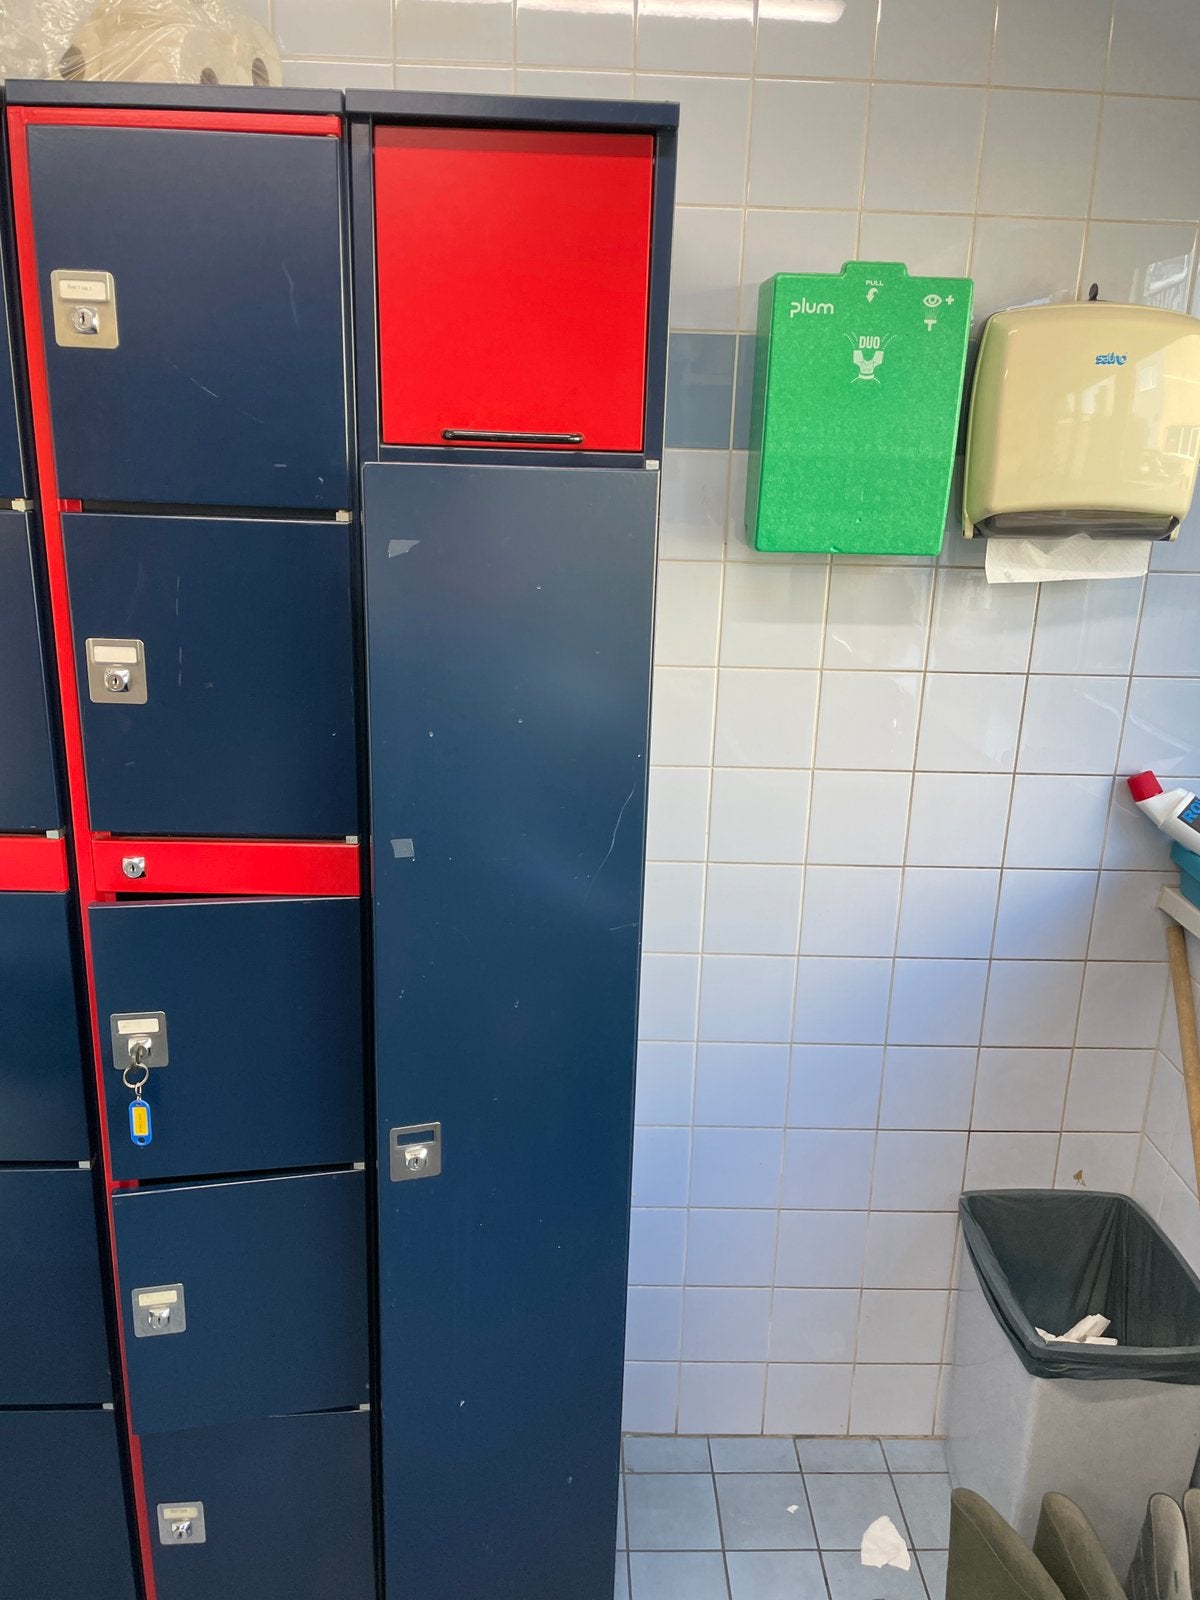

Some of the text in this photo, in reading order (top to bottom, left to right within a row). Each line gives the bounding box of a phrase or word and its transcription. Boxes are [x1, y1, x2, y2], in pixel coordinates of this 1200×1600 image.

[790, 297, 834, 318] plum
[859, 335, 881, 349] DUO
[1183, 798, 1200, 824] RO
